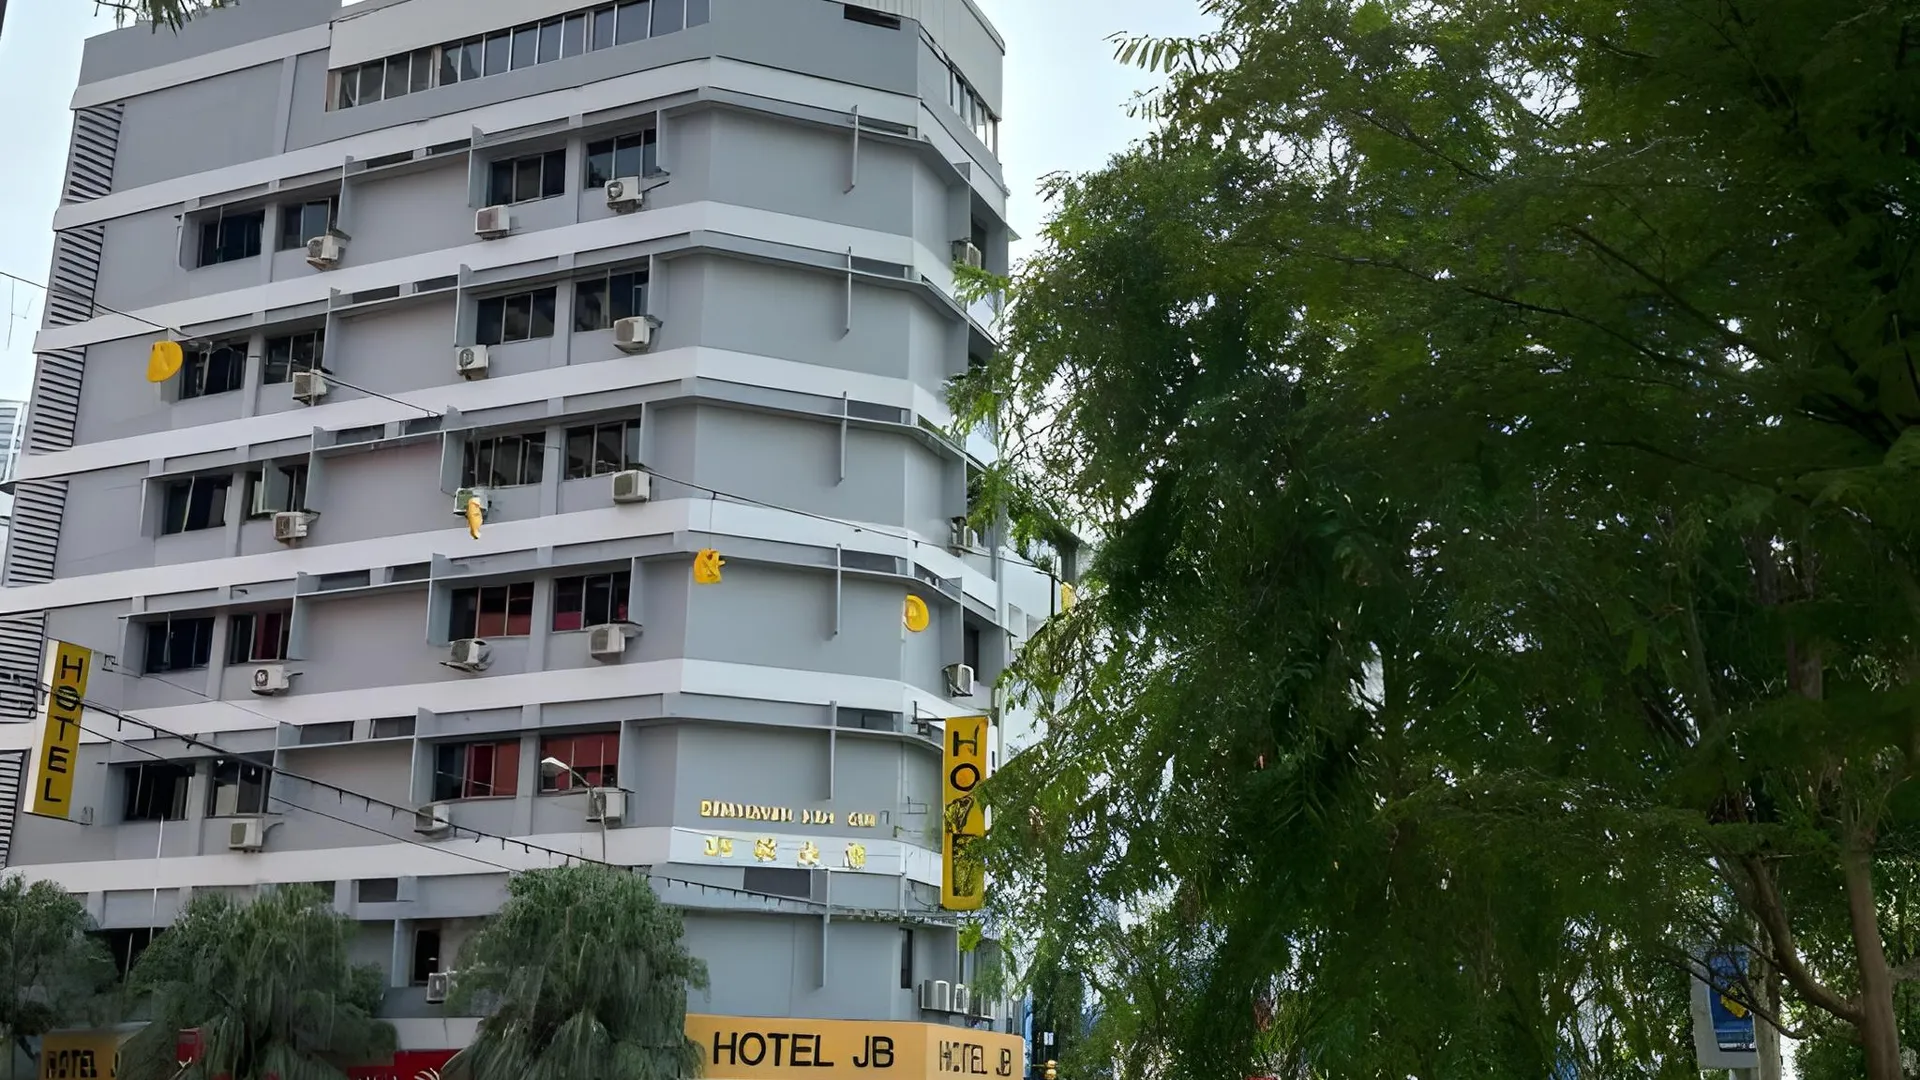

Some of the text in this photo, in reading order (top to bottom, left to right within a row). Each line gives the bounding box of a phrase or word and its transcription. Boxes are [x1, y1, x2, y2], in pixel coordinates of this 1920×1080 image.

[44, 654, 83, 803] HOTEL
[713, 1031, 895, 1069] HOTEL JB
